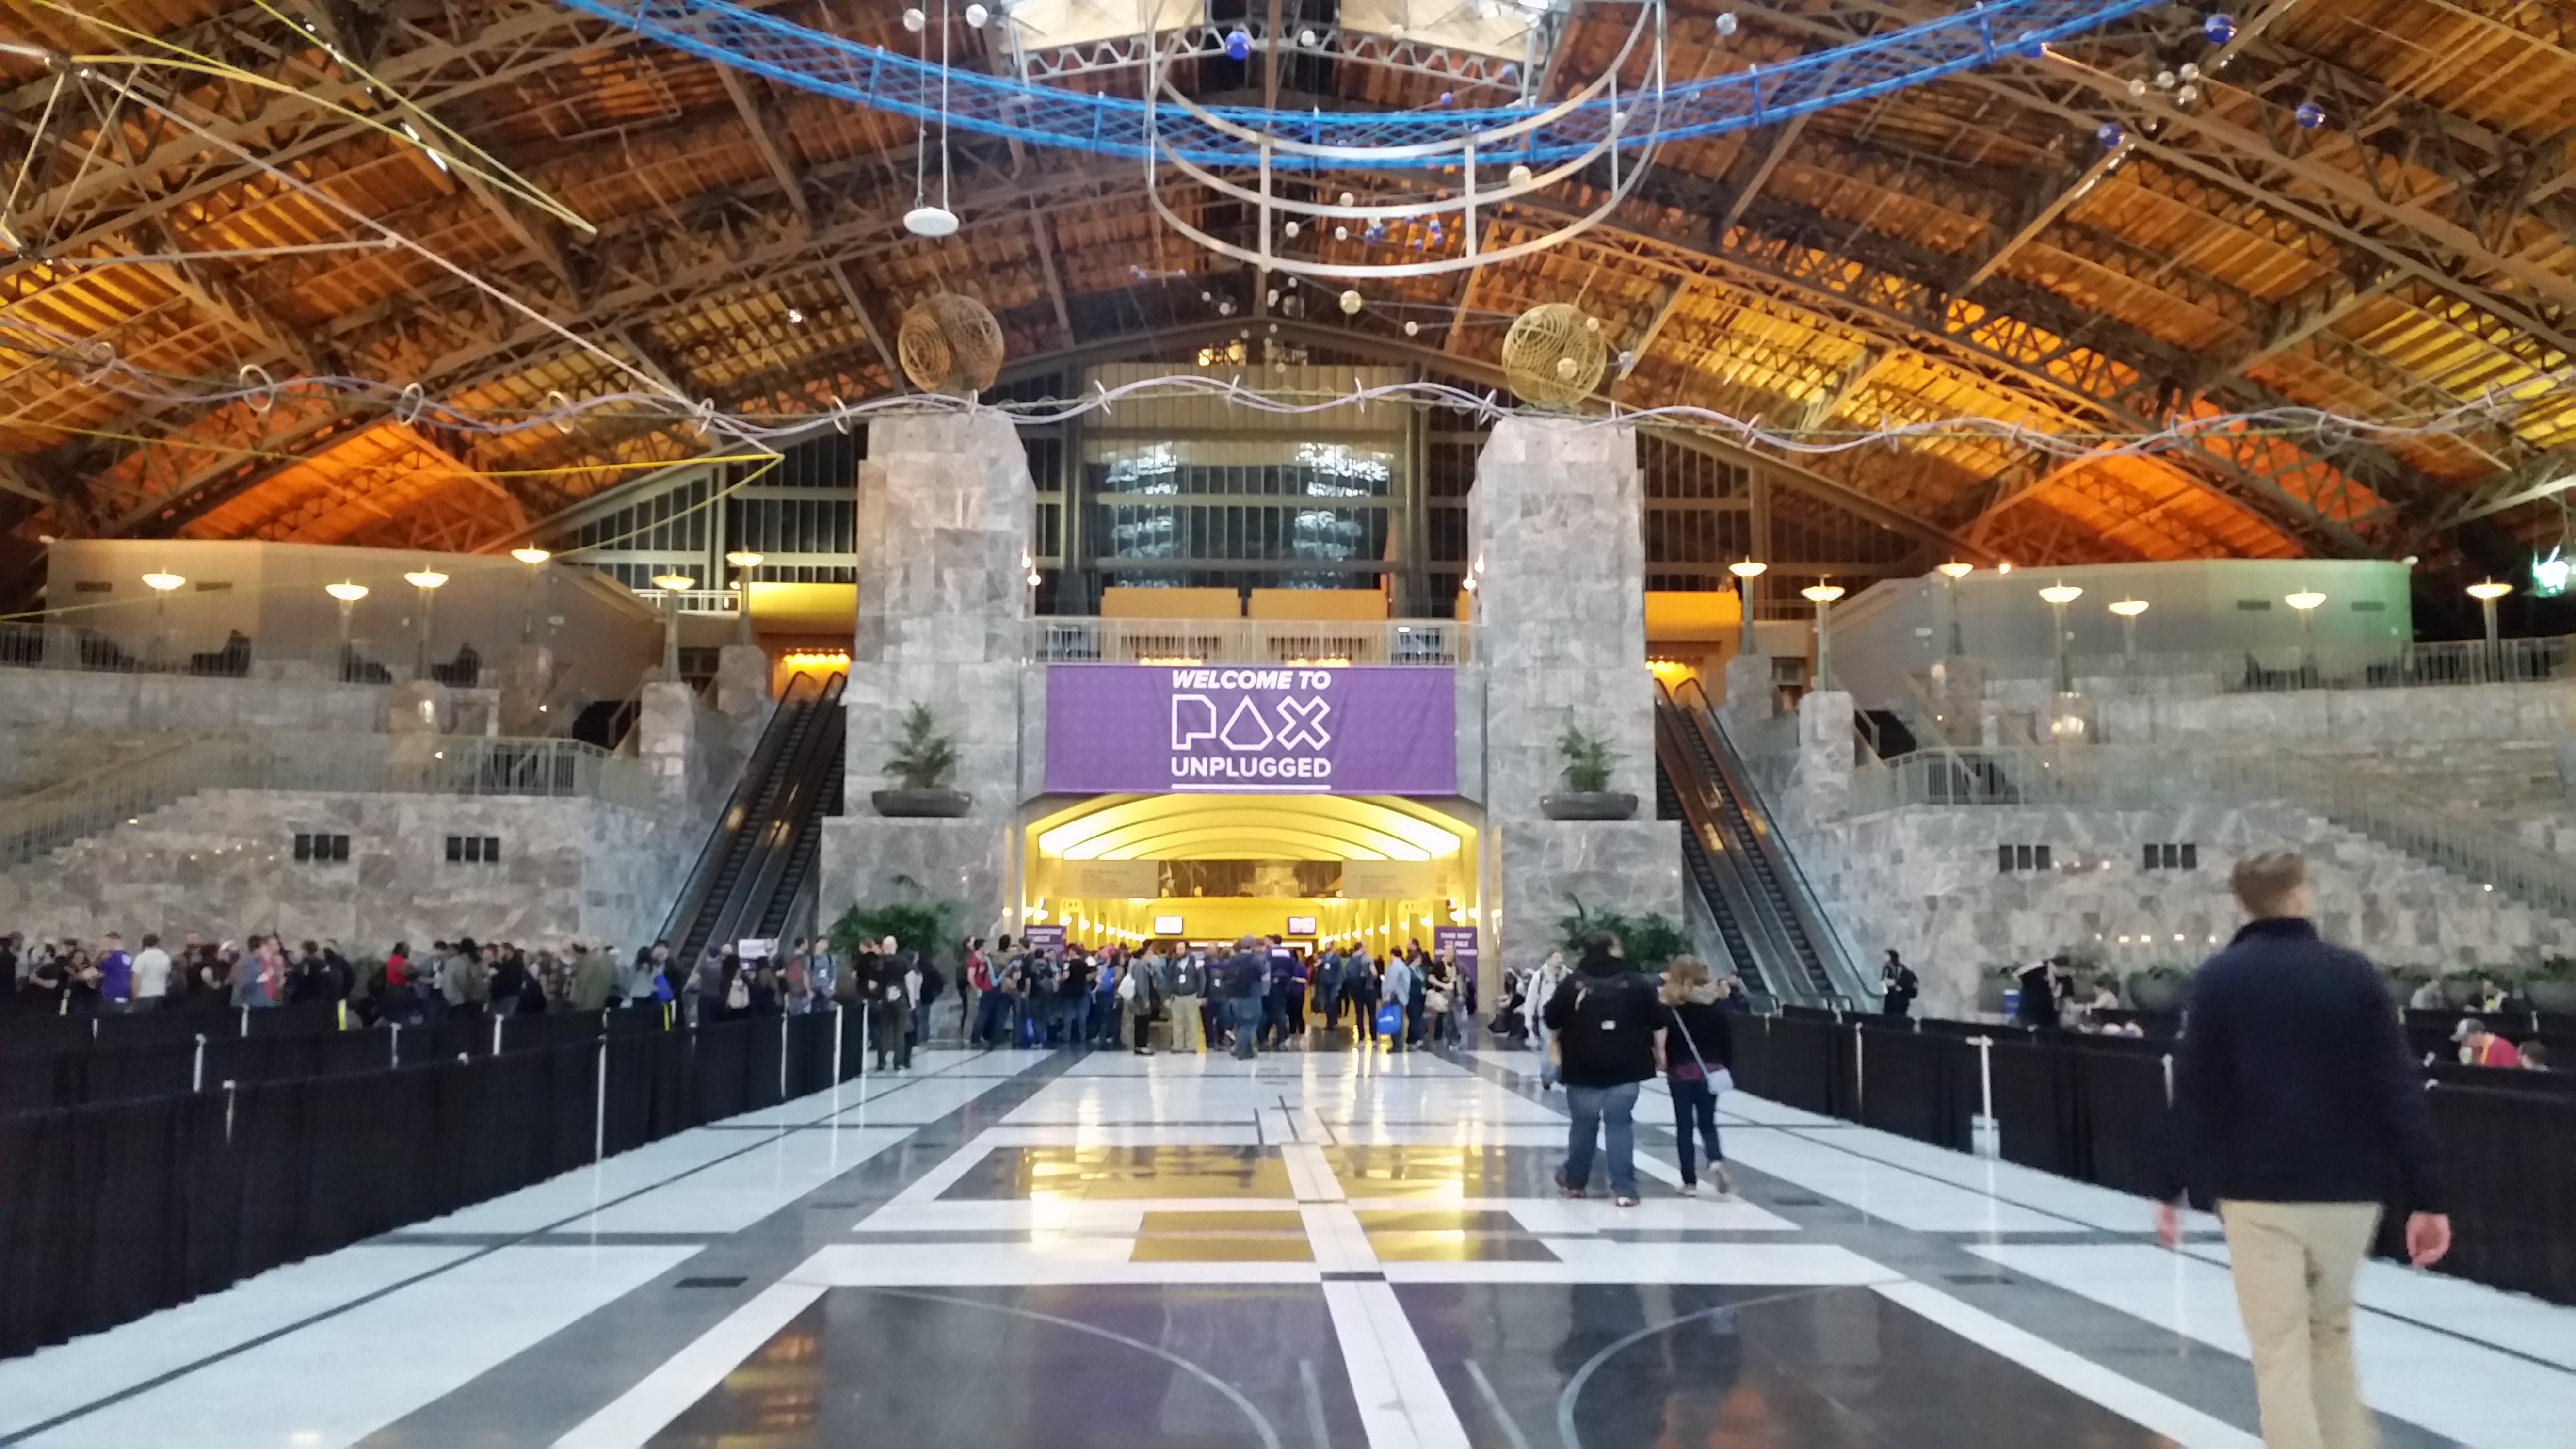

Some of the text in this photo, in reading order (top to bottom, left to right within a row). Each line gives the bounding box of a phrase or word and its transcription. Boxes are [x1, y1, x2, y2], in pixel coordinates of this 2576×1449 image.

[1172, 669, 1332, 690] WELCOME TO
[1171, 693, 1332, 751] PAX
[1171, 756, 1332, 778] UNPLUGGED
